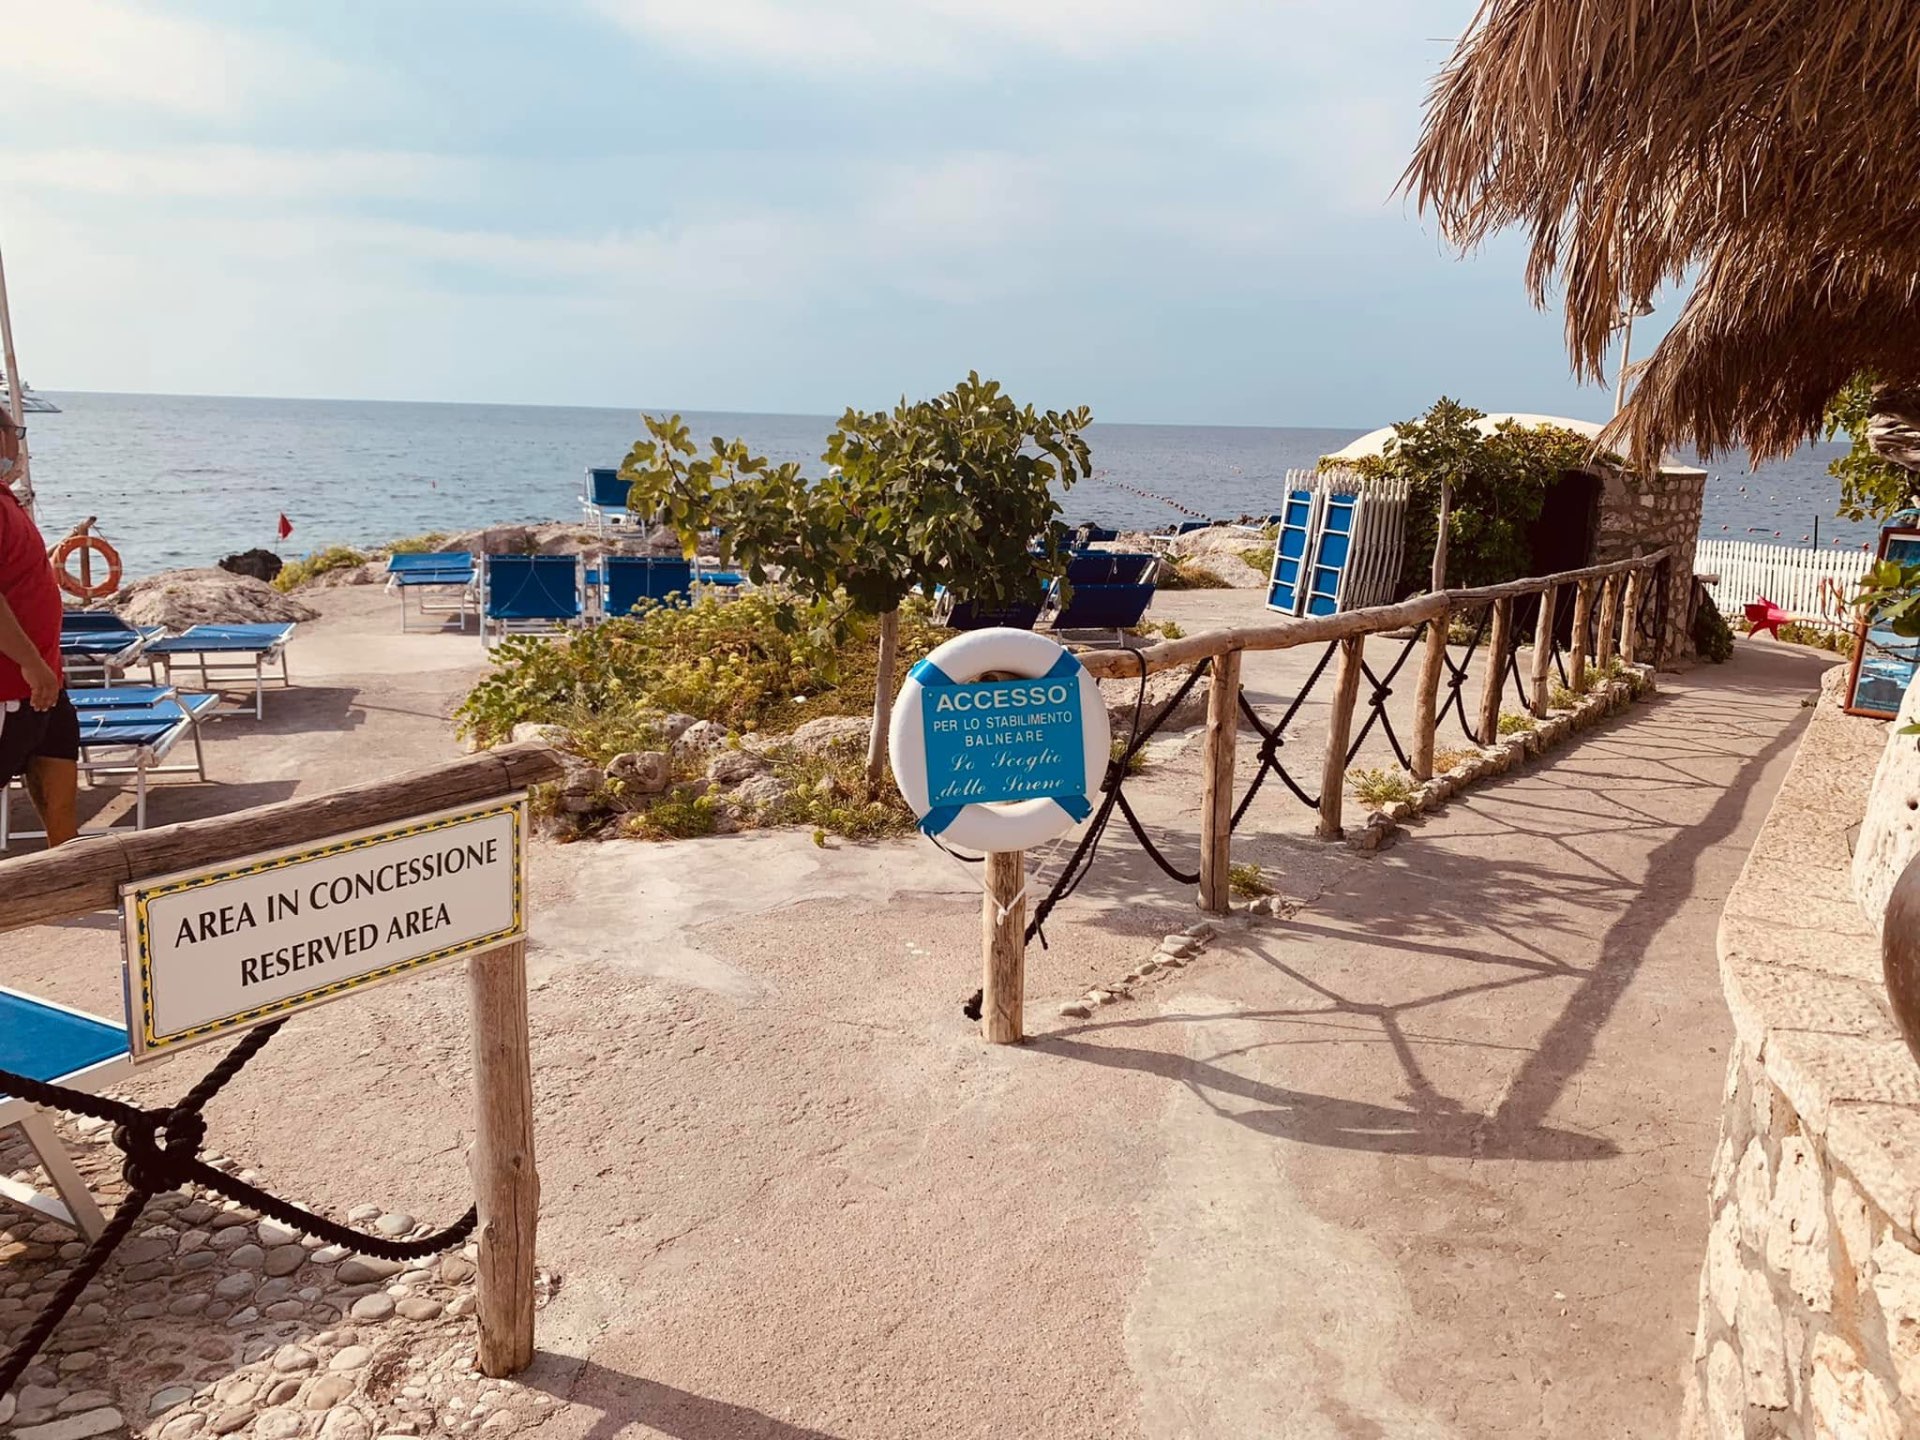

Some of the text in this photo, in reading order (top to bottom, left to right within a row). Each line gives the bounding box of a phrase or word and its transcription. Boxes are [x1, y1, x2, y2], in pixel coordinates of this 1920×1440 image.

[936, 685, 1067, 713] ACCESSO
[934, 711, 1072, 732] PER LO STABILIMENTO
[965, 730, 1044, 747] BALNEARE
[991, 748, 1062, 774] Scoglio
[940, 775, 1065, 798] delle Sirene
[174, 838, 498, 949] AREA IN CONCESSIONE
[240, 902, 451, 987] RESERVED AREA
